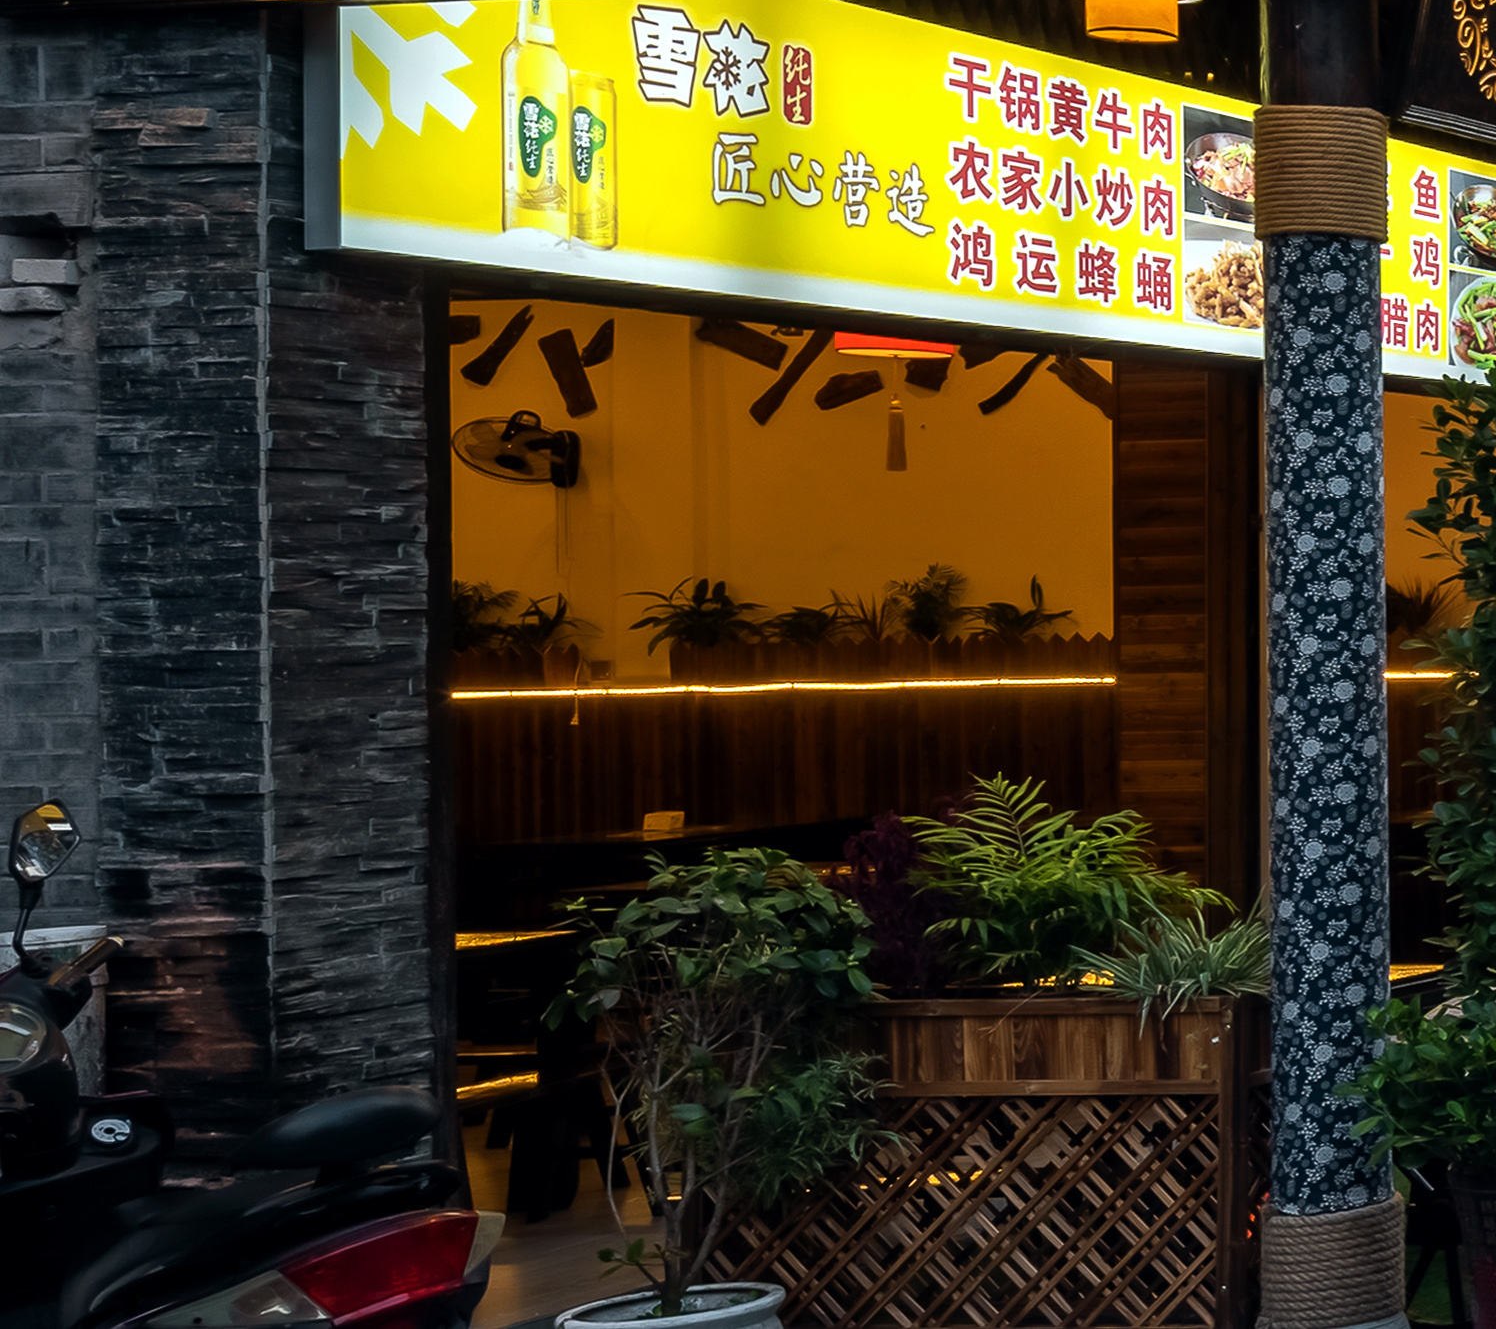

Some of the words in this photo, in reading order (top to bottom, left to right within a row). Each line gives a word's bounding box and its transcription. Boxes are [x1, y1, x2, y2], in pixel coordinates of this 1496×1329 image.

[632, 4, 770, 118] 雪花
[783, 44, 812, 125] 纯生
[948, 56, 1174, 161] 干锅黄牛肉
[711, 131, 936, 237] 匠心营造
[950, 141, 1174, 236] 农家小炒肉
[950, 222, 1174, 312] 鸿运蜂蛹
